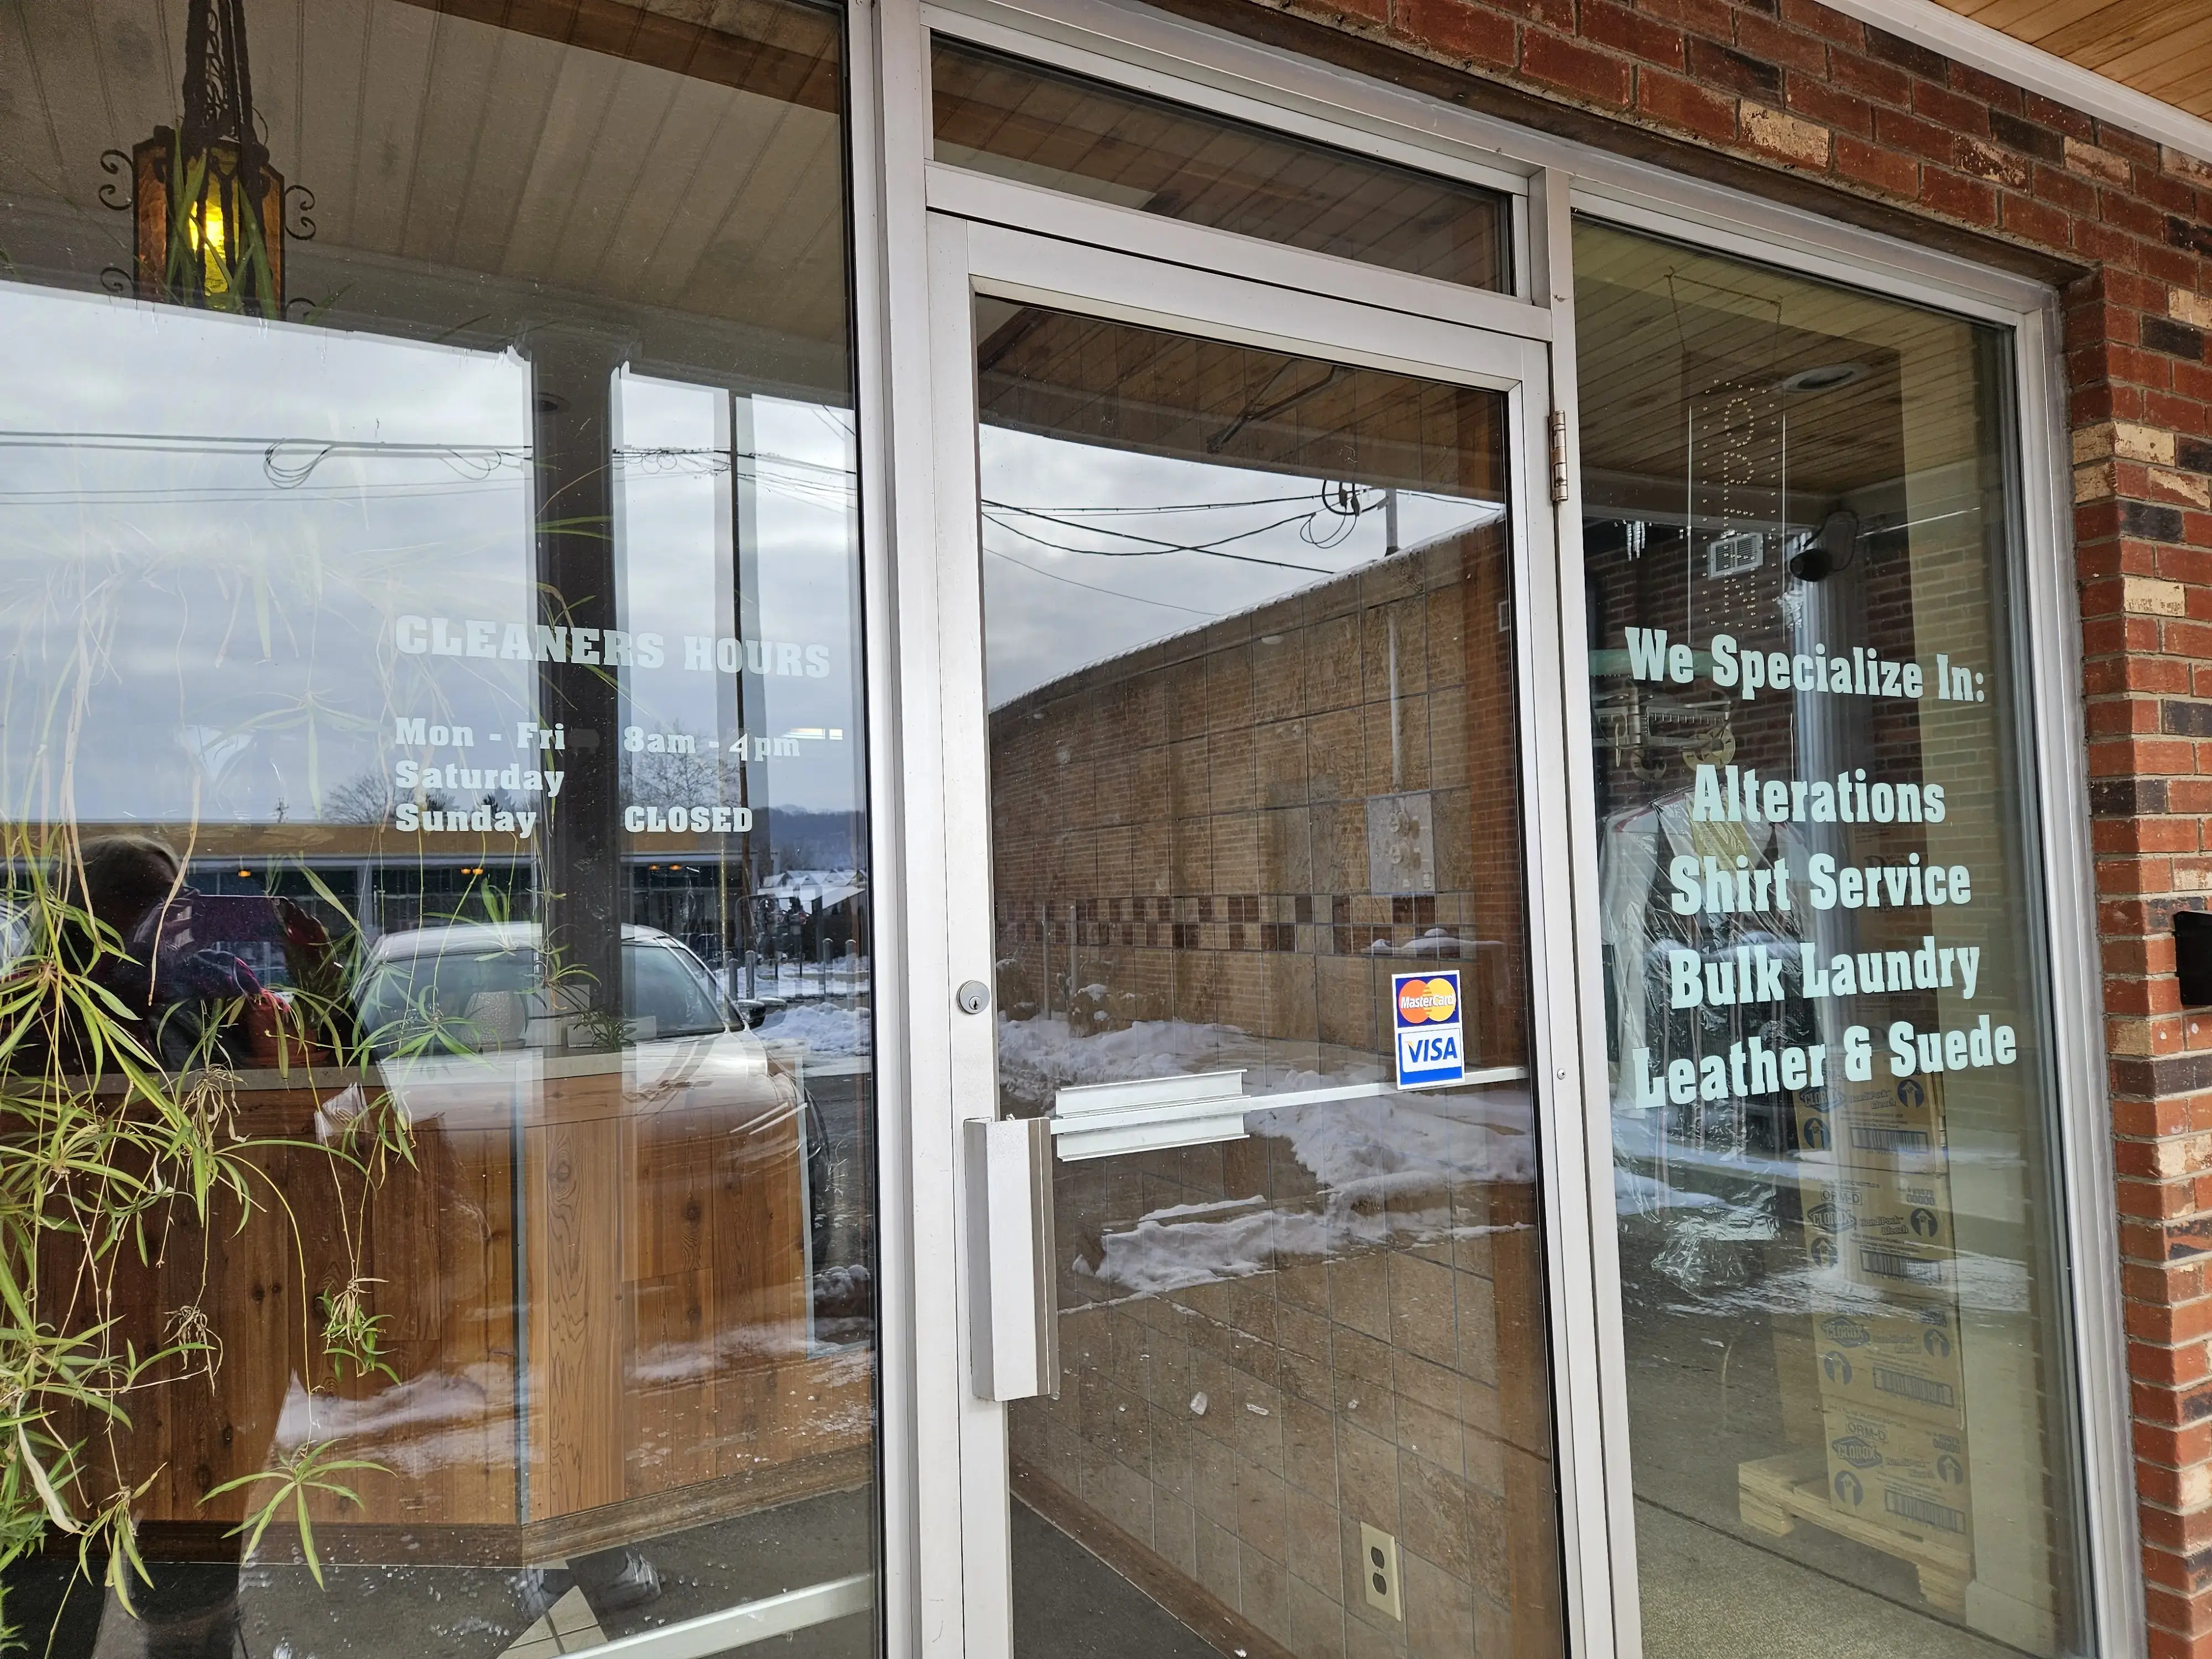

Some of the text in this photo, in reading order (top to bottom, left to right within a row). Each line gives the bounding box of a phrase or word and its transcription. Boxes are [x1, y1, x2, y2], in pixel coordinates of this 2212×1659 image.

[395, 615, 830, 679] CLEANERS HOURS
[1625, 627, 1985, 702] We Specialize In:
[395, 717, 473, 747] Mon
[517, 722, 565, 749] Fri
[624, 726, 696, 754] 8am
[395, 760, 565, 797] Saturday
[1692, 764, 1946, 823] Alterations
[395, 803, 753, 839] Sunday CLOSED
[1670, 854, 1791, 915] Shirt
[1808, 852, 1971, 910] Service
[1669, 936, 1980, 1009] Bulk Laundry
[1401, 994, 1455, 1009] MasterCard
[1408, 1037, 1458, 1063] VISA
[1632, 1014, 2017, 1110] Leather & Suede
[1813, 1125, 1820, 1134] UP
[1822, 1189, 1860, 1203] ORM-D
[1813, 1209, 1851, 1227] CLOROX
[1882, 1225, 1909, 1235] Bleach
[1838, 1444, 1877, 1459] CLOROX
